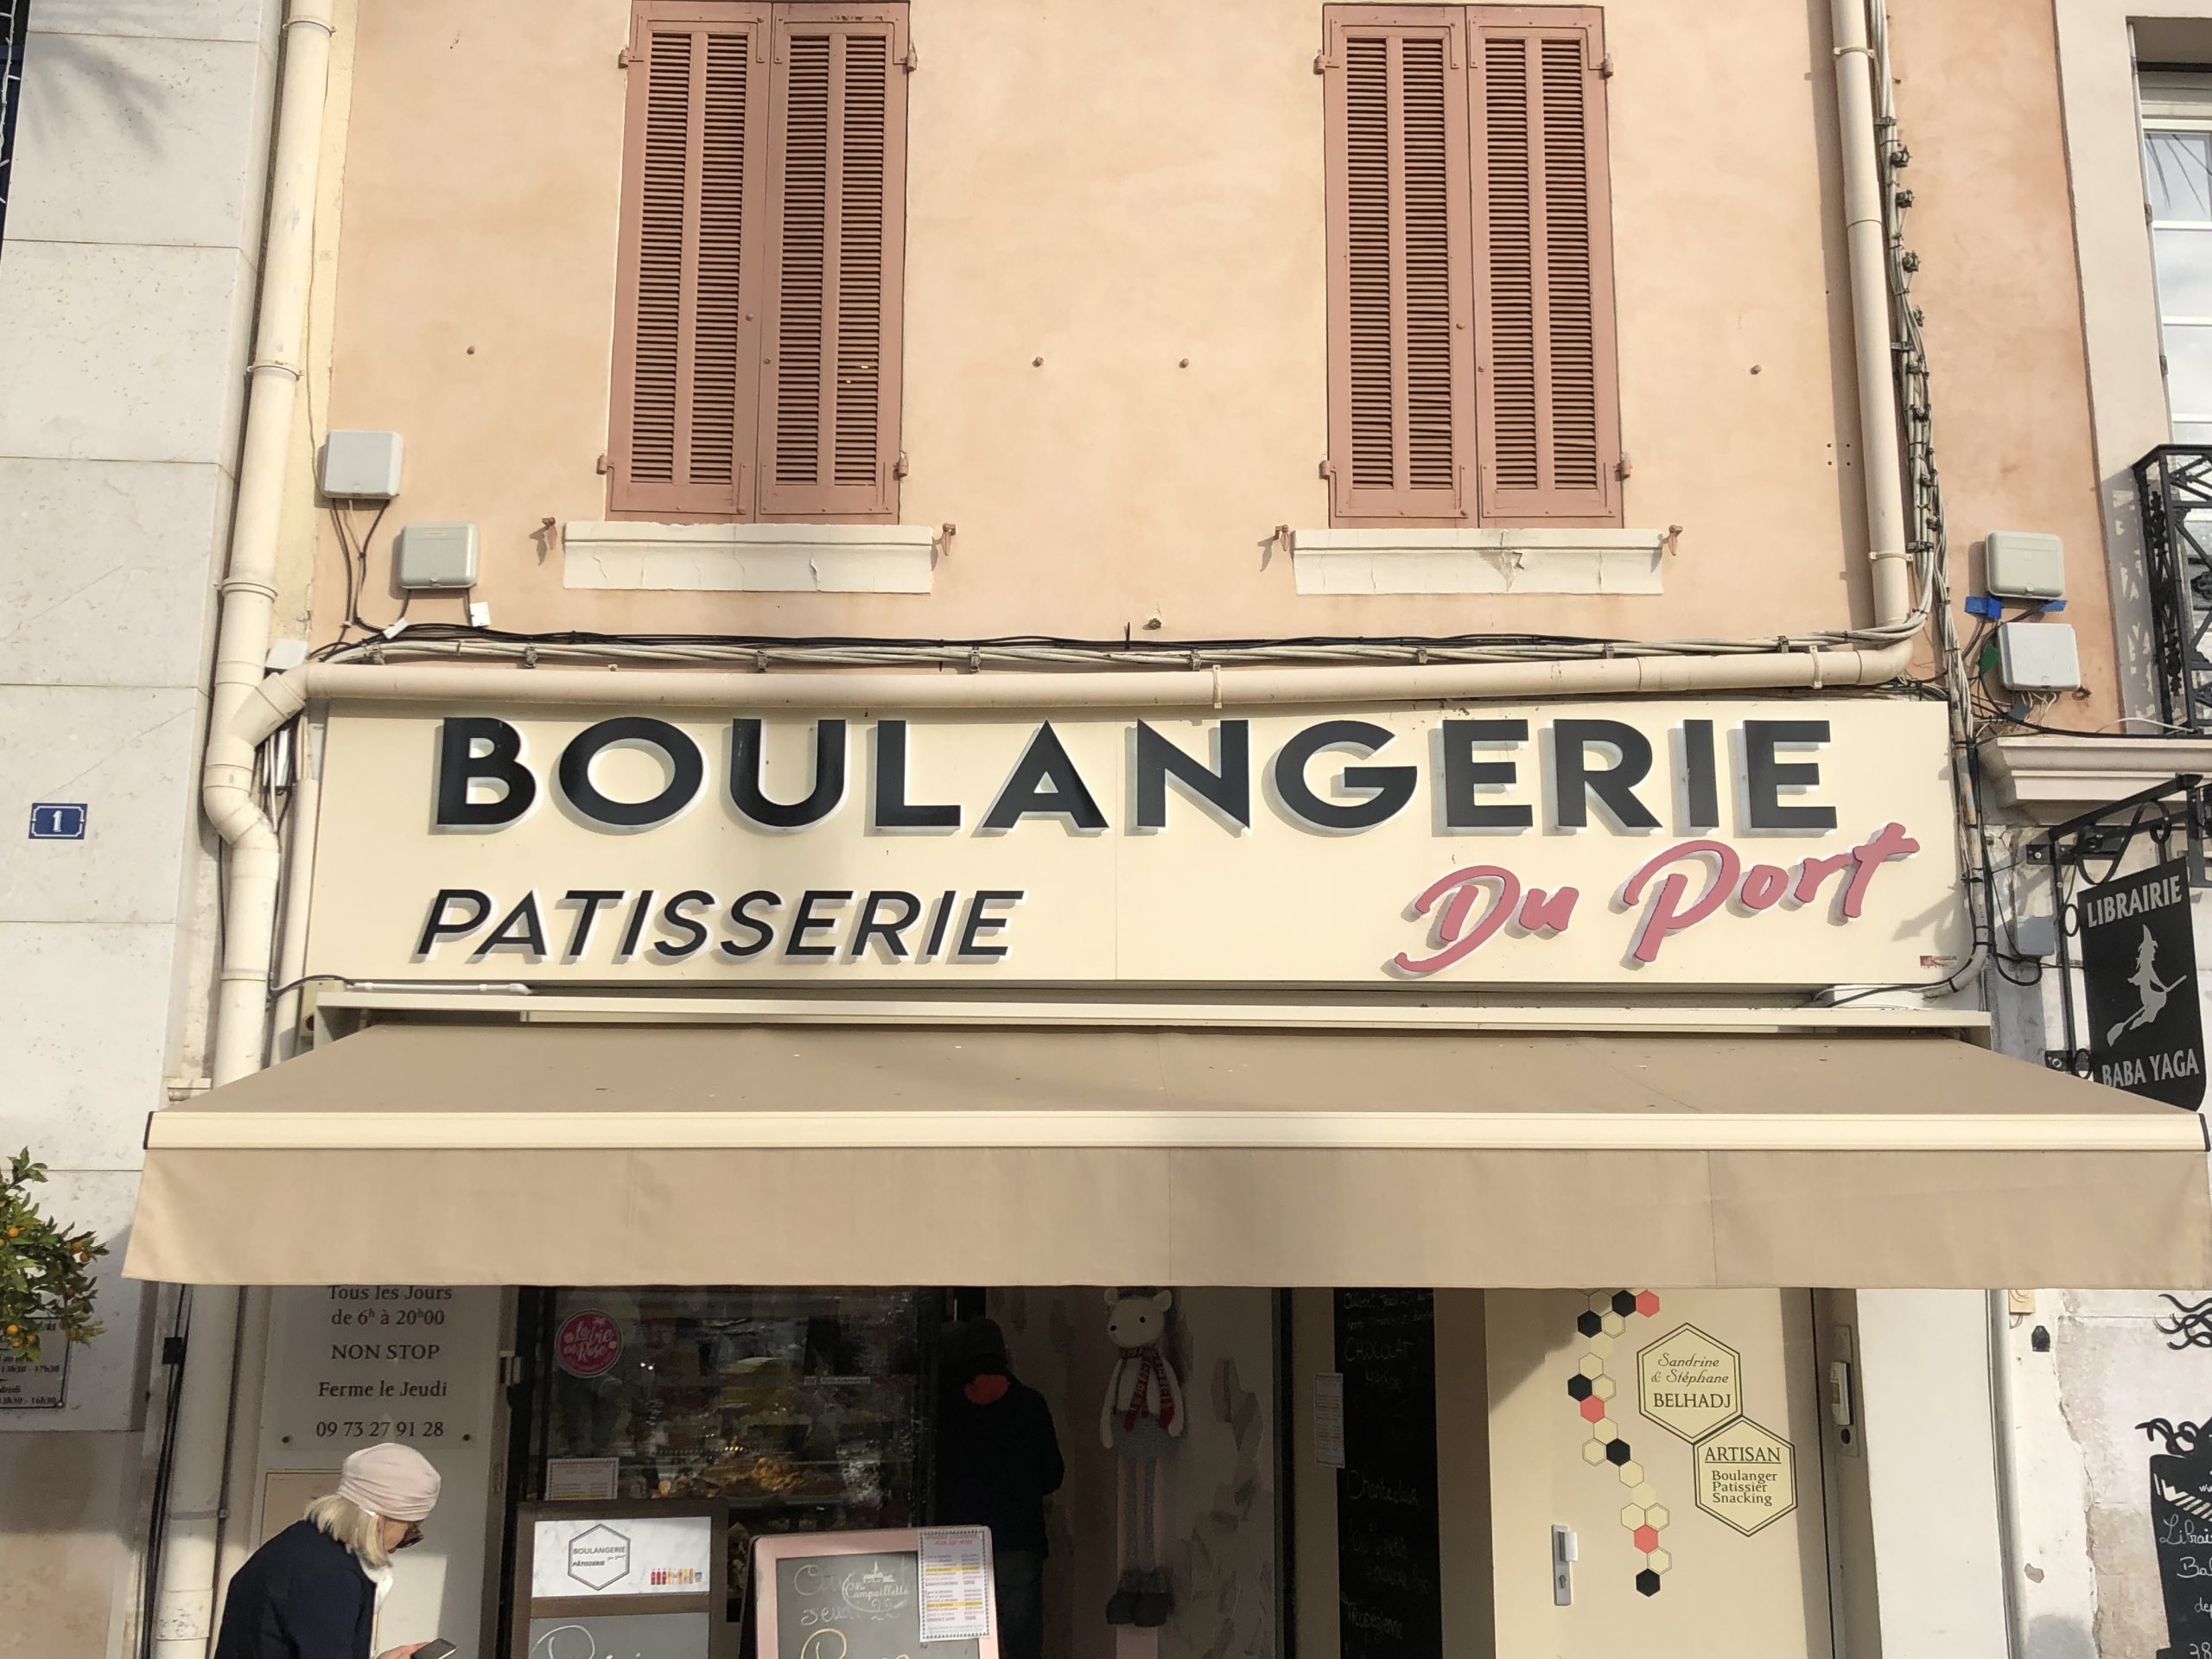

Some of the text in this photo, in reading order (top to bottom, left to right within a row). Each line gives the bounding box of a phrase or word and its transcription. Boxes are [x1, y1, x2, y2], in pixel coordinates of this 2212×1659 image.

[435, 715, 1839, 830] BOULANGERIE
[52, 810, 62, 832] 1
[1394, 822, 1921, 973] Du Port
[2087, 874, 2183, 928] LIBRAIRIE
[417, 888, 1026, 957] PATISSERIE
[2101, 1048, 2200, 1088] BABA YAGA
[328, 1285, 454, 1300] Tous les Jours
[331, 1308, 353, 1325] de
[380, 1309, 390, 1325] à
[396, 1308, 445, 1325] 20h00
[331, 1344, 441, 1360] NON STOP
[1657, 1352, 1719, 1367] Sandrine
[1651, 1369, 1729, 1387] & Stéphane
[318, 1380, 448, 1397] Ferme le Jeudi
[1653, 1393, 1732, 1408] BELHADJ
[315, 1421, 444, 1438] 09 73 27 91 28
[1704, 1446, 1782, 1462] ARTISAN
[1712, 1469, 1778, 1484] Boulanger
[1713, 1481, 1768, 1492] Patissier
[1713, 1492, 1773, 1507] Snacking
[2159, 1514, 2212, 1545] Librai
[573, 1546, 626, 1555] BOULANGERIE
